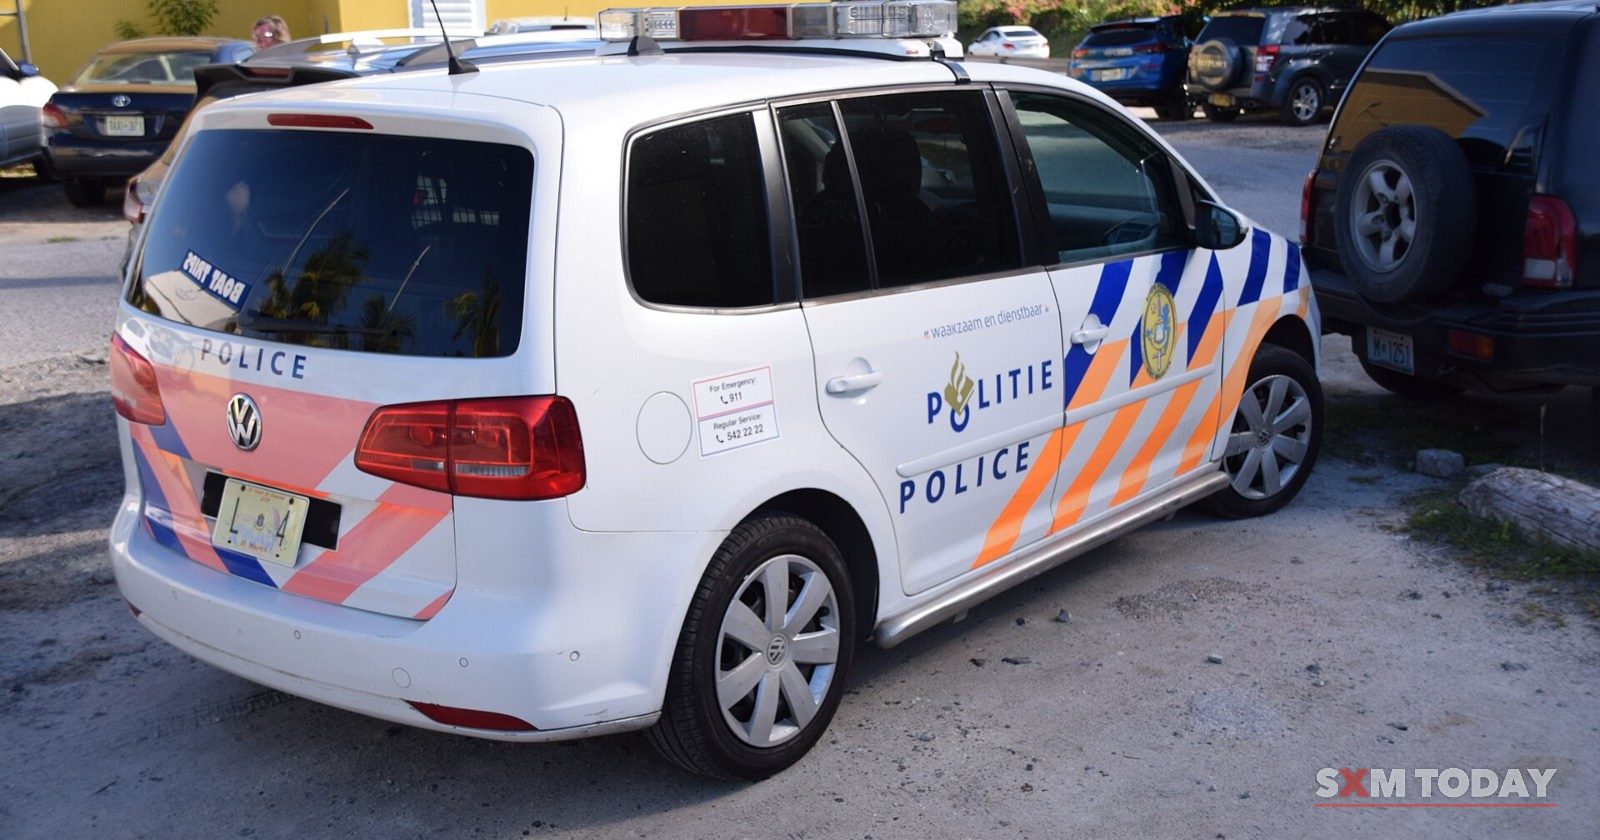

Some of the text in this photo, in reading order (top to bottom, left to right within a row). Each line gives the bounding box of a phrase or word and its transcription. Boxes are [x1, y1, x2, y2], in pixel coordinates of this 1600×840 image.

[984, 315, 996, 328] en
[201, 338, 308, 379] POLICE
[709, 377, 757, 393] For Emergency:
[729, 392, 743, 403] 911
[926, 359, 1053, 433] POLITIE
[713, 413, 762, 431] Regular Service:
[727, 424, 764, 441] 542 22 22
[899, 441, 1030, 514] POLICE
